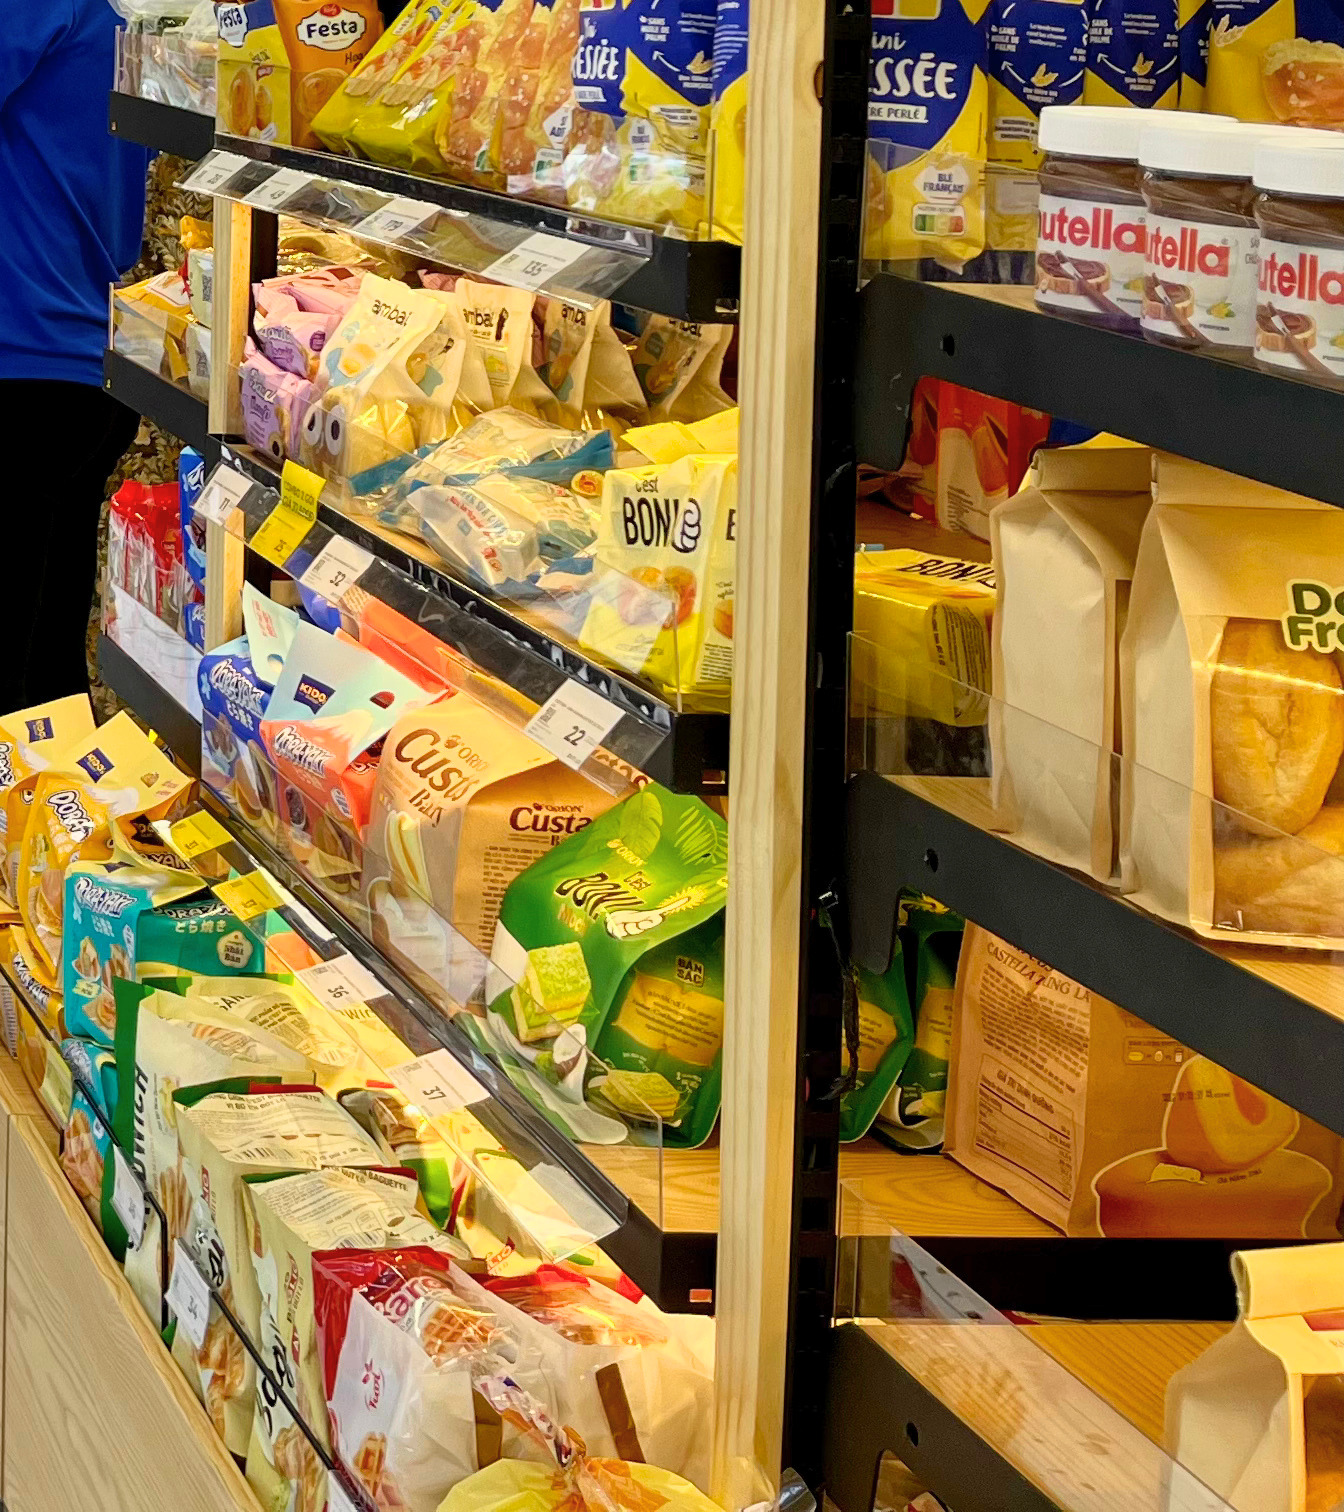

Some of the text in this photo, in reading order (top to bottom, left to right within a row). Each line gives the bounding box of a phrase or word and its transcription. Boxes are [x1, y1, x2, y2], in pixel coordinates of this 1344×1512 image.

[873, 31, 906, 51] ini
[869, 53, 957, 100] SSÉE
[1041, 207, 1146, 254] utella
[1145, 226, 1230, 278] utella
[1259, 253, 1344, 306] utella
[330, 571, 346, 586] 32
[564, 726, 585, 746] 22
[509, 807, 592, 834] Custa
[987, 941, 1035, 981] CASTELLA
[328, 986, 349, 998] 36
[423, 1086, 446, 1099] 37
